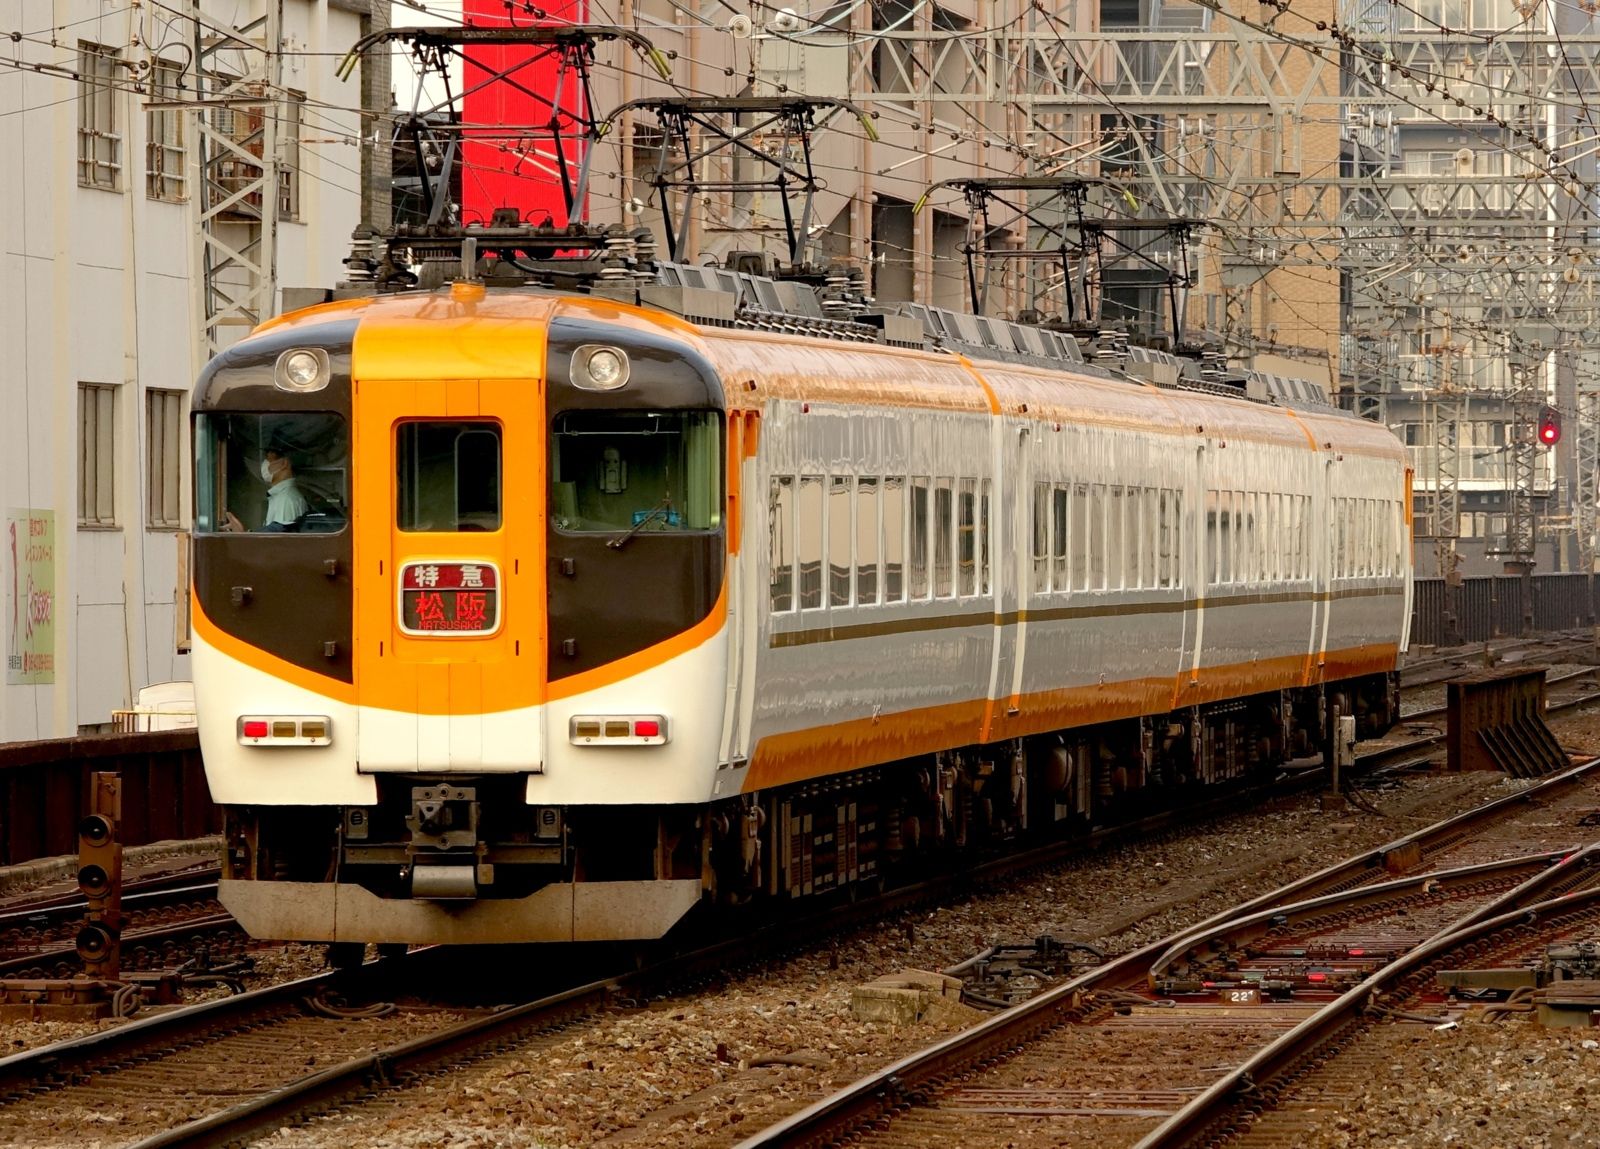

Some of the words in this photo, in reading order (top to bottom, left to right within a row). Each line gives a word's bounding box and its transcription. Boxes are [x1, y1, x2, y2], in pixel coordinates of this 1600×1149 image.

[415, 565, 483, 587] 特急
[416, 592, 486, 620] 松阪
[419, 620, 482, 631] MATSUSAKA
